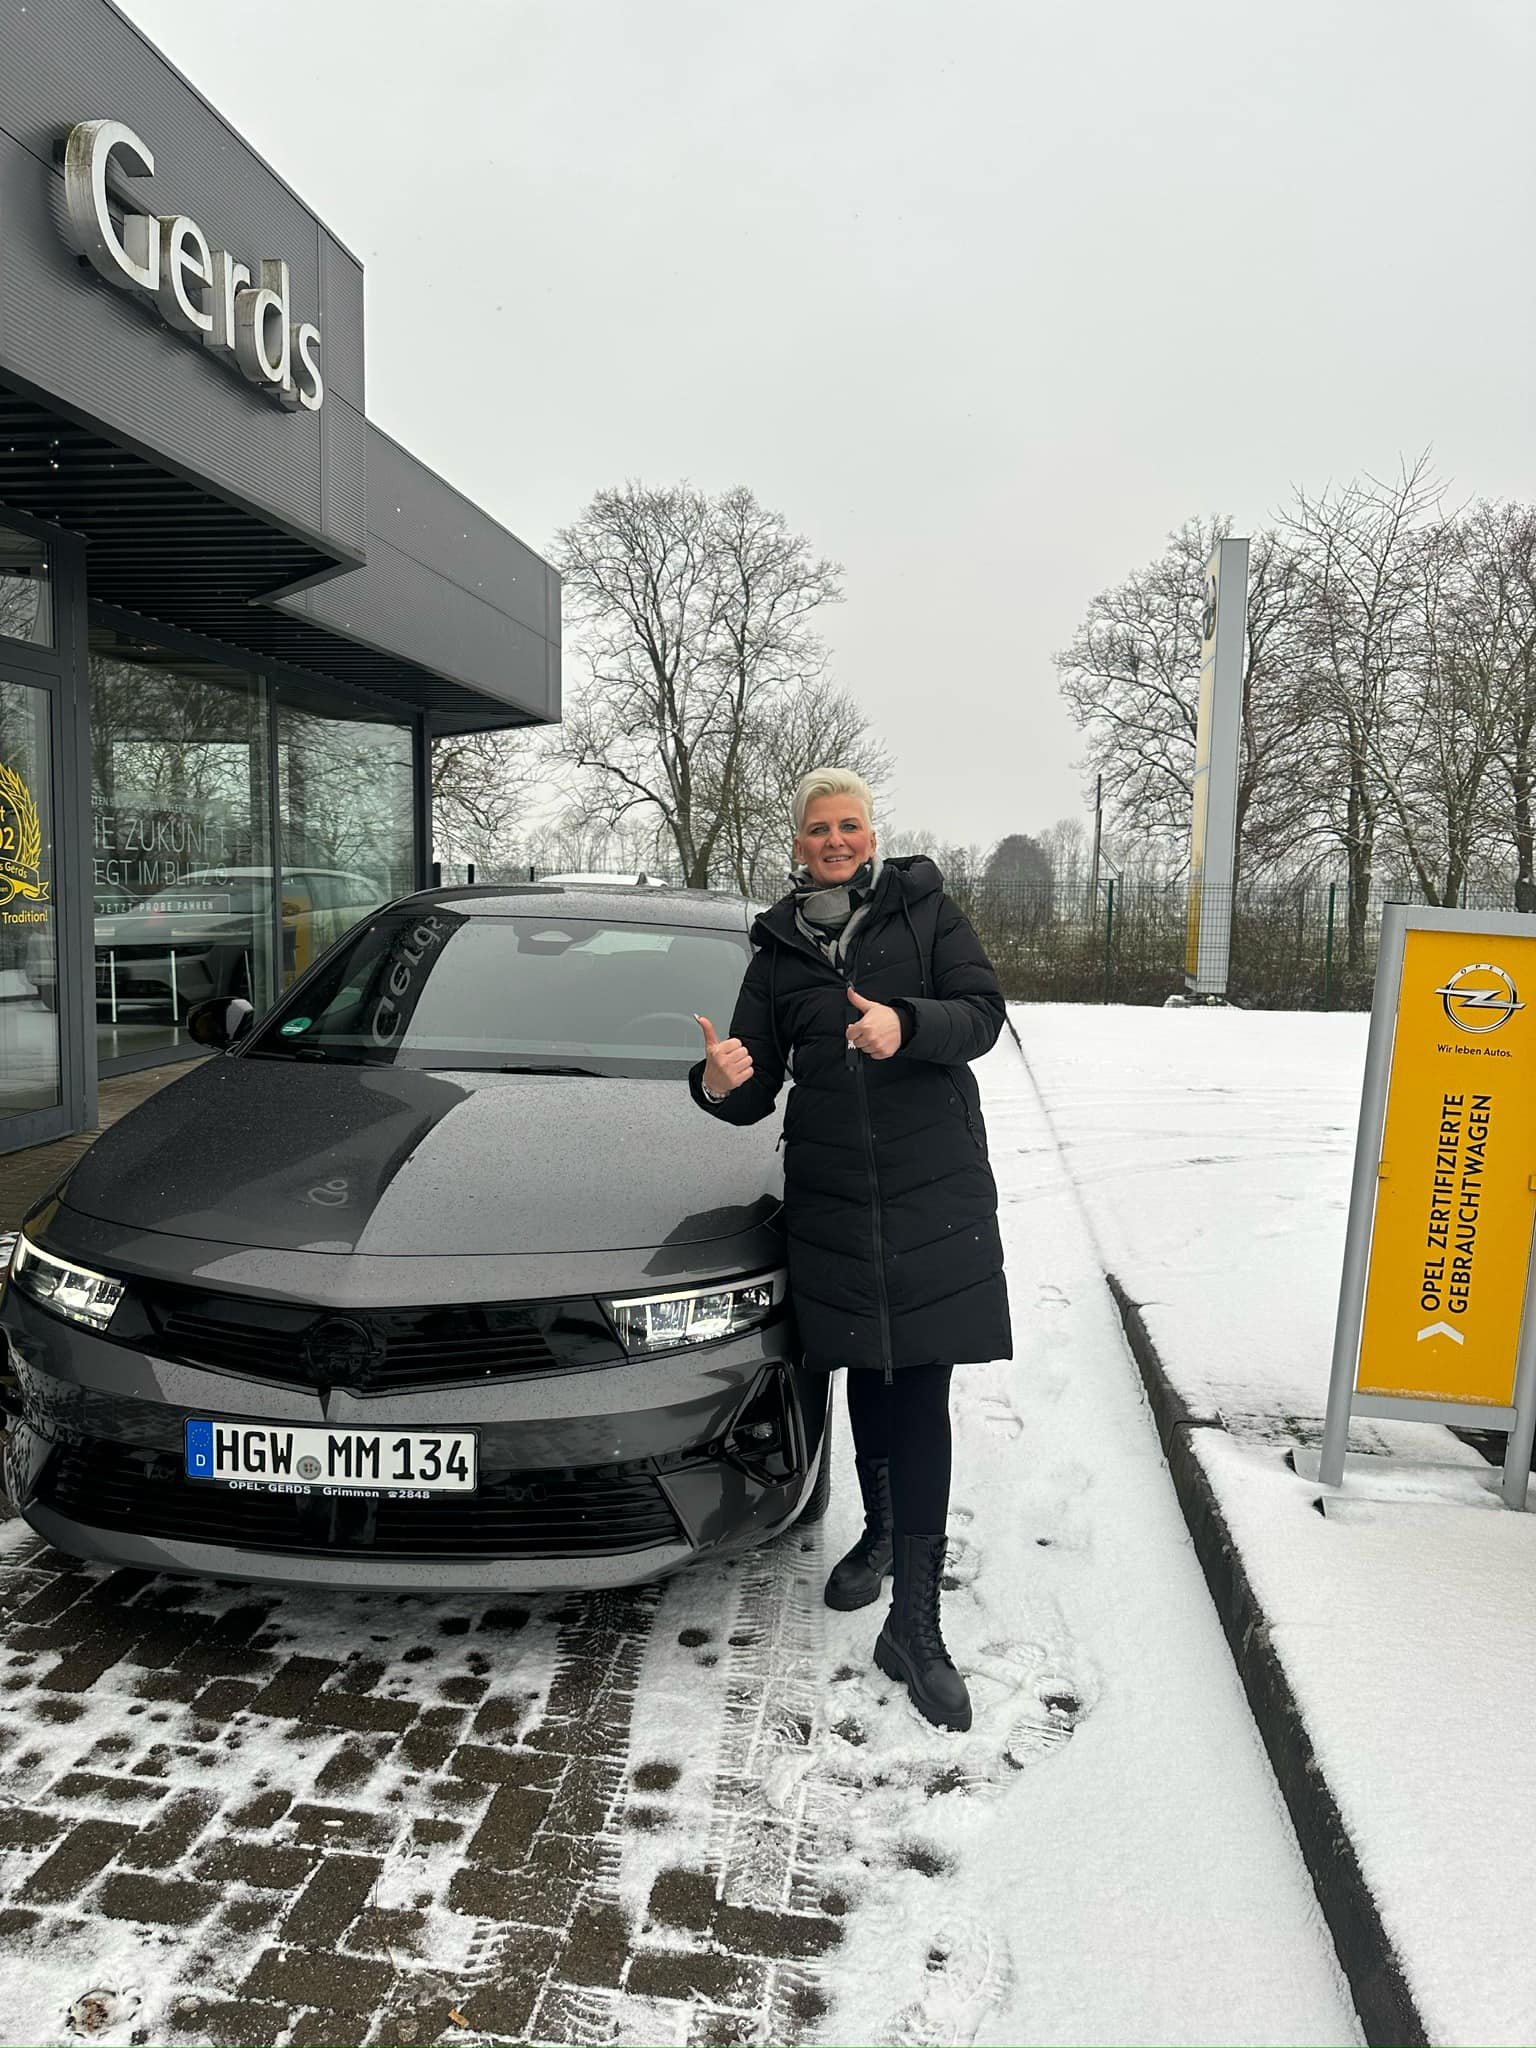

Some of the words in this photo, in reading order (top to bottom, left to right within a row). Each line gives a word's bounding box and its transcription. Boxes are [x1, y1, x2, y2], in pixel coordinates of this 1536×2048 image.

[66, 119, 323, 411] Gerds
[94, 815, 116, 849] IE
[124, 818, 231, 858] ZUKUNFT
[93, 858, 132, 886] EGT
[138, 860, 160, 886] IM
[2, 909, 49, 925] Tradition!
[100, 903, 132, 914] JETZT
[140, 902, 172, 912] PROBE
[1460, 963, 1506, 978] OPEL
[1437, 1043, 1453, 1053] Wir
[1455, 1044, 1482, 1055] leben
[1483, 1047, 1513, 1058] Autos.
[1427, 1093, 1465, 1250] ZERTIFIZIERTE
[1447, 1094, 1492, 1314] GEBRAUCHTWAGEN
[1420, 1256, 1446, 1312] OPEL
[195, 1454, 206, 1467] D
[216, 1429, 294, 1475] HGW
[327, 1434, 381, 1479] MM
[392, 1438, 469, 1482] 134
[268, 1482, 312, 1495] GERDS
[322, 1486, 380, 1498] Grimmen
